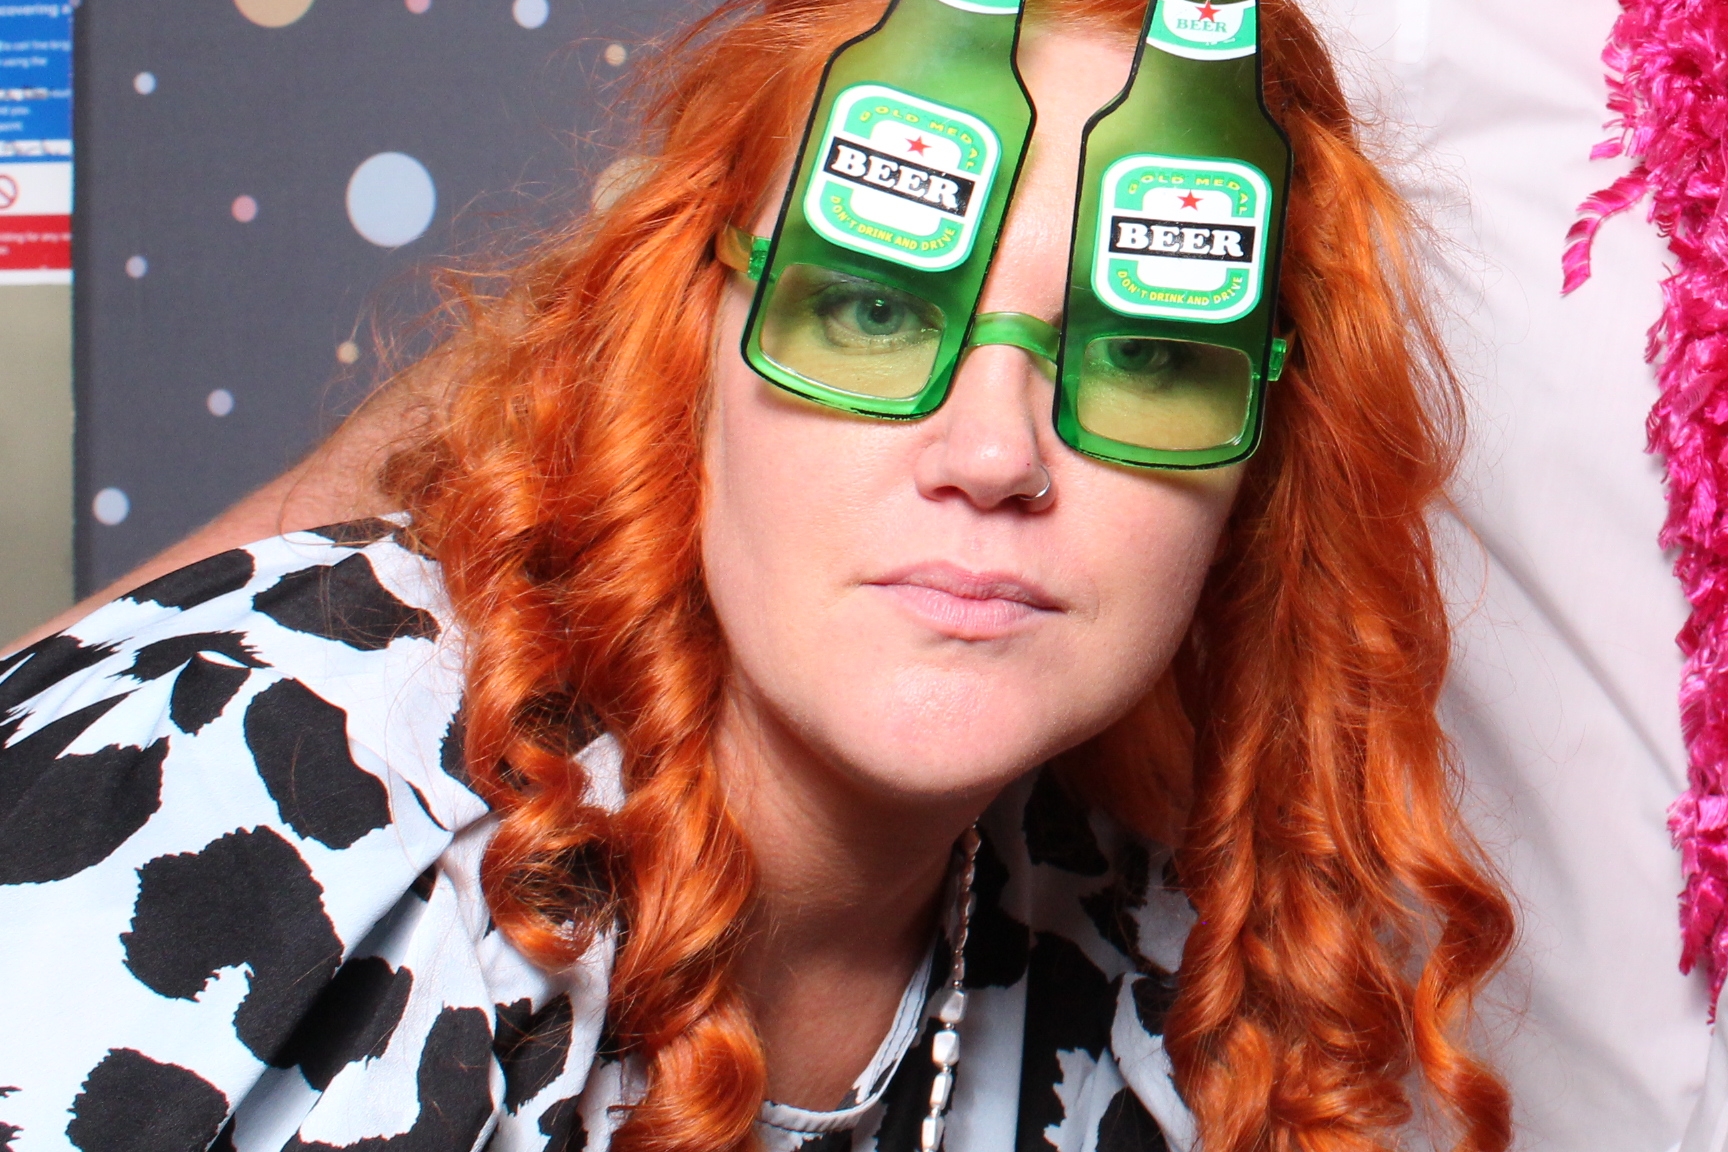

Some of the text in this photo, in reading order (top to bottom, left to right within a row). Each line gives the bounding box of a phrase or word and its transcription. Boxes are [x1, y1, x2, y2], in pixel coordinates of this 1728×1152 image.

[1176, 18, 1227, 33] BEER
[859, 105, 979, 170] GOLD MEDAL
[830, 144, 960, 210] BEER
[1128, 173, 1249, 216] GOLD MEDAL
[830, 195, 956, 251] DON'T DRINK AND DRIVE
[1115, 221, 1245, 258] BEER
[1117, 269, 1243, 306] DON'T DRINK AND DRIVE
